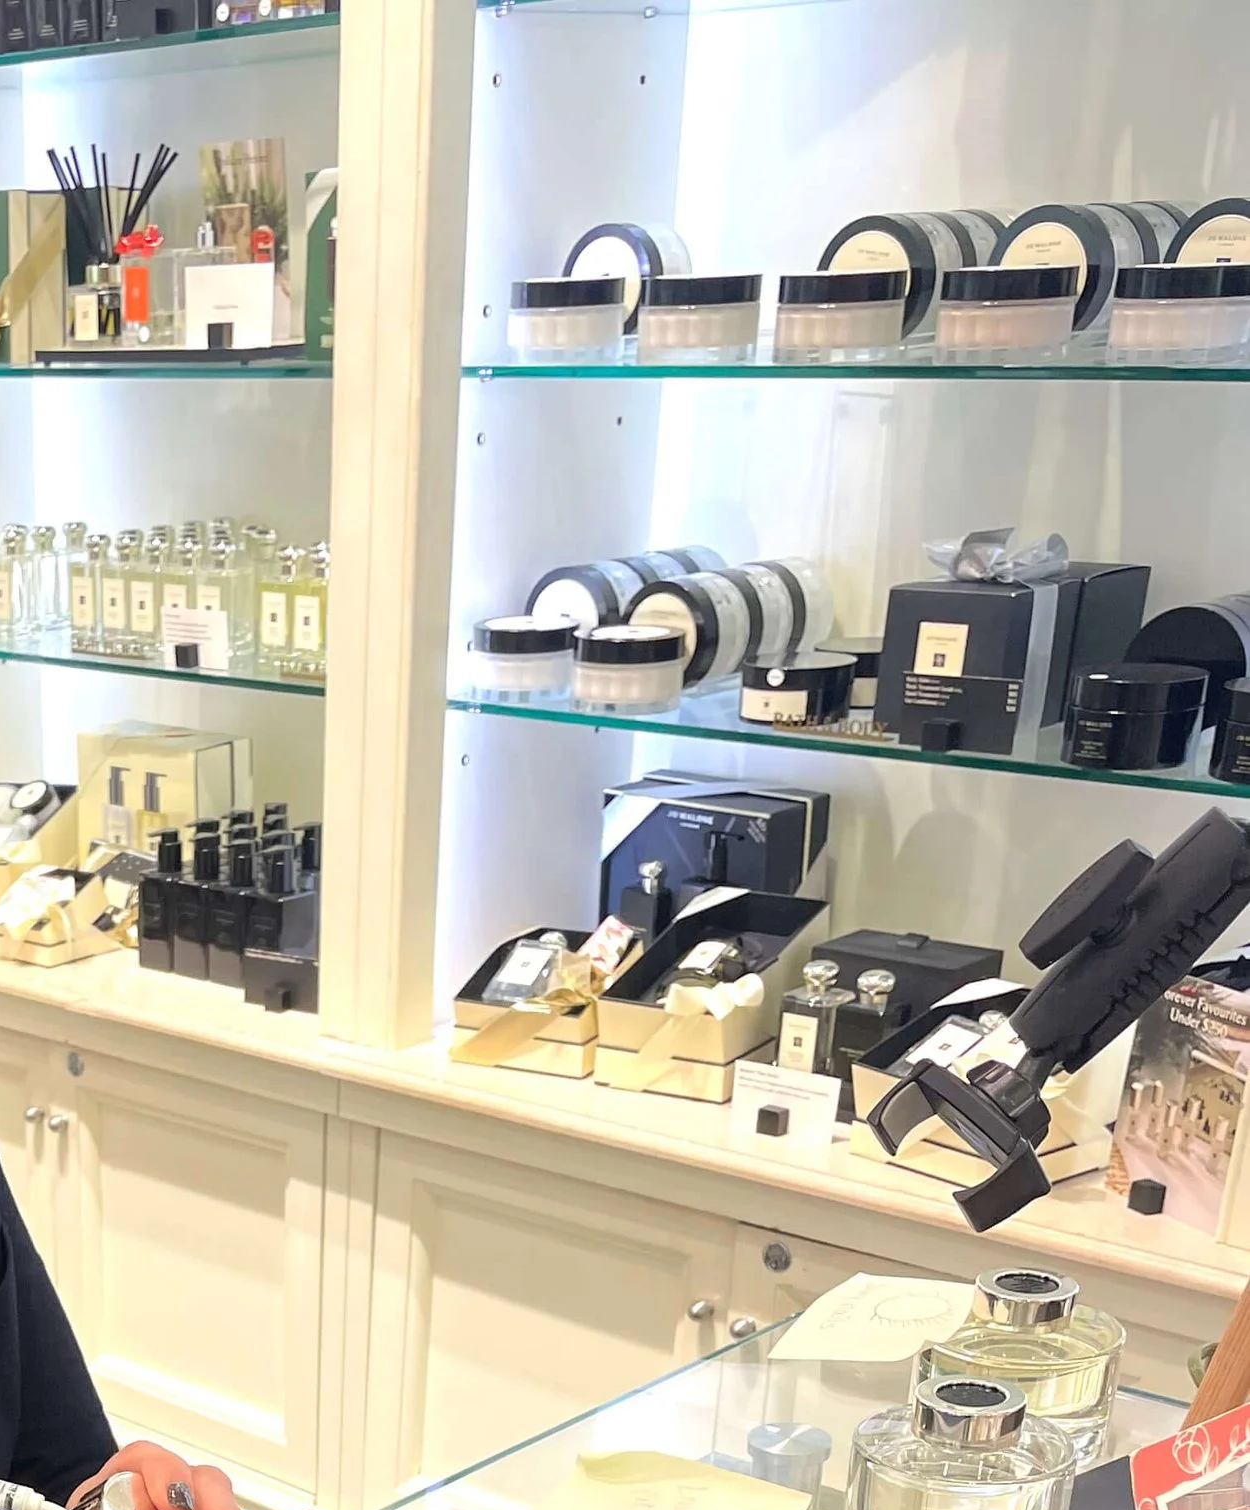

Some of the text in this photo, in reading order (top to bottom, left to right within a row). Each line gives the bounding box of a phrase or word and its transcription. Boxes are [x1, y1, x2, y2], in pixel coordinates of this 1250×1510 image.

[773, 712, 818, 728] BATH
[839, 717, 889, 737] BODY
[1164, 990, 1248, 1026] orever Favourites
[1170, 1007, 1201, 1029] Under
